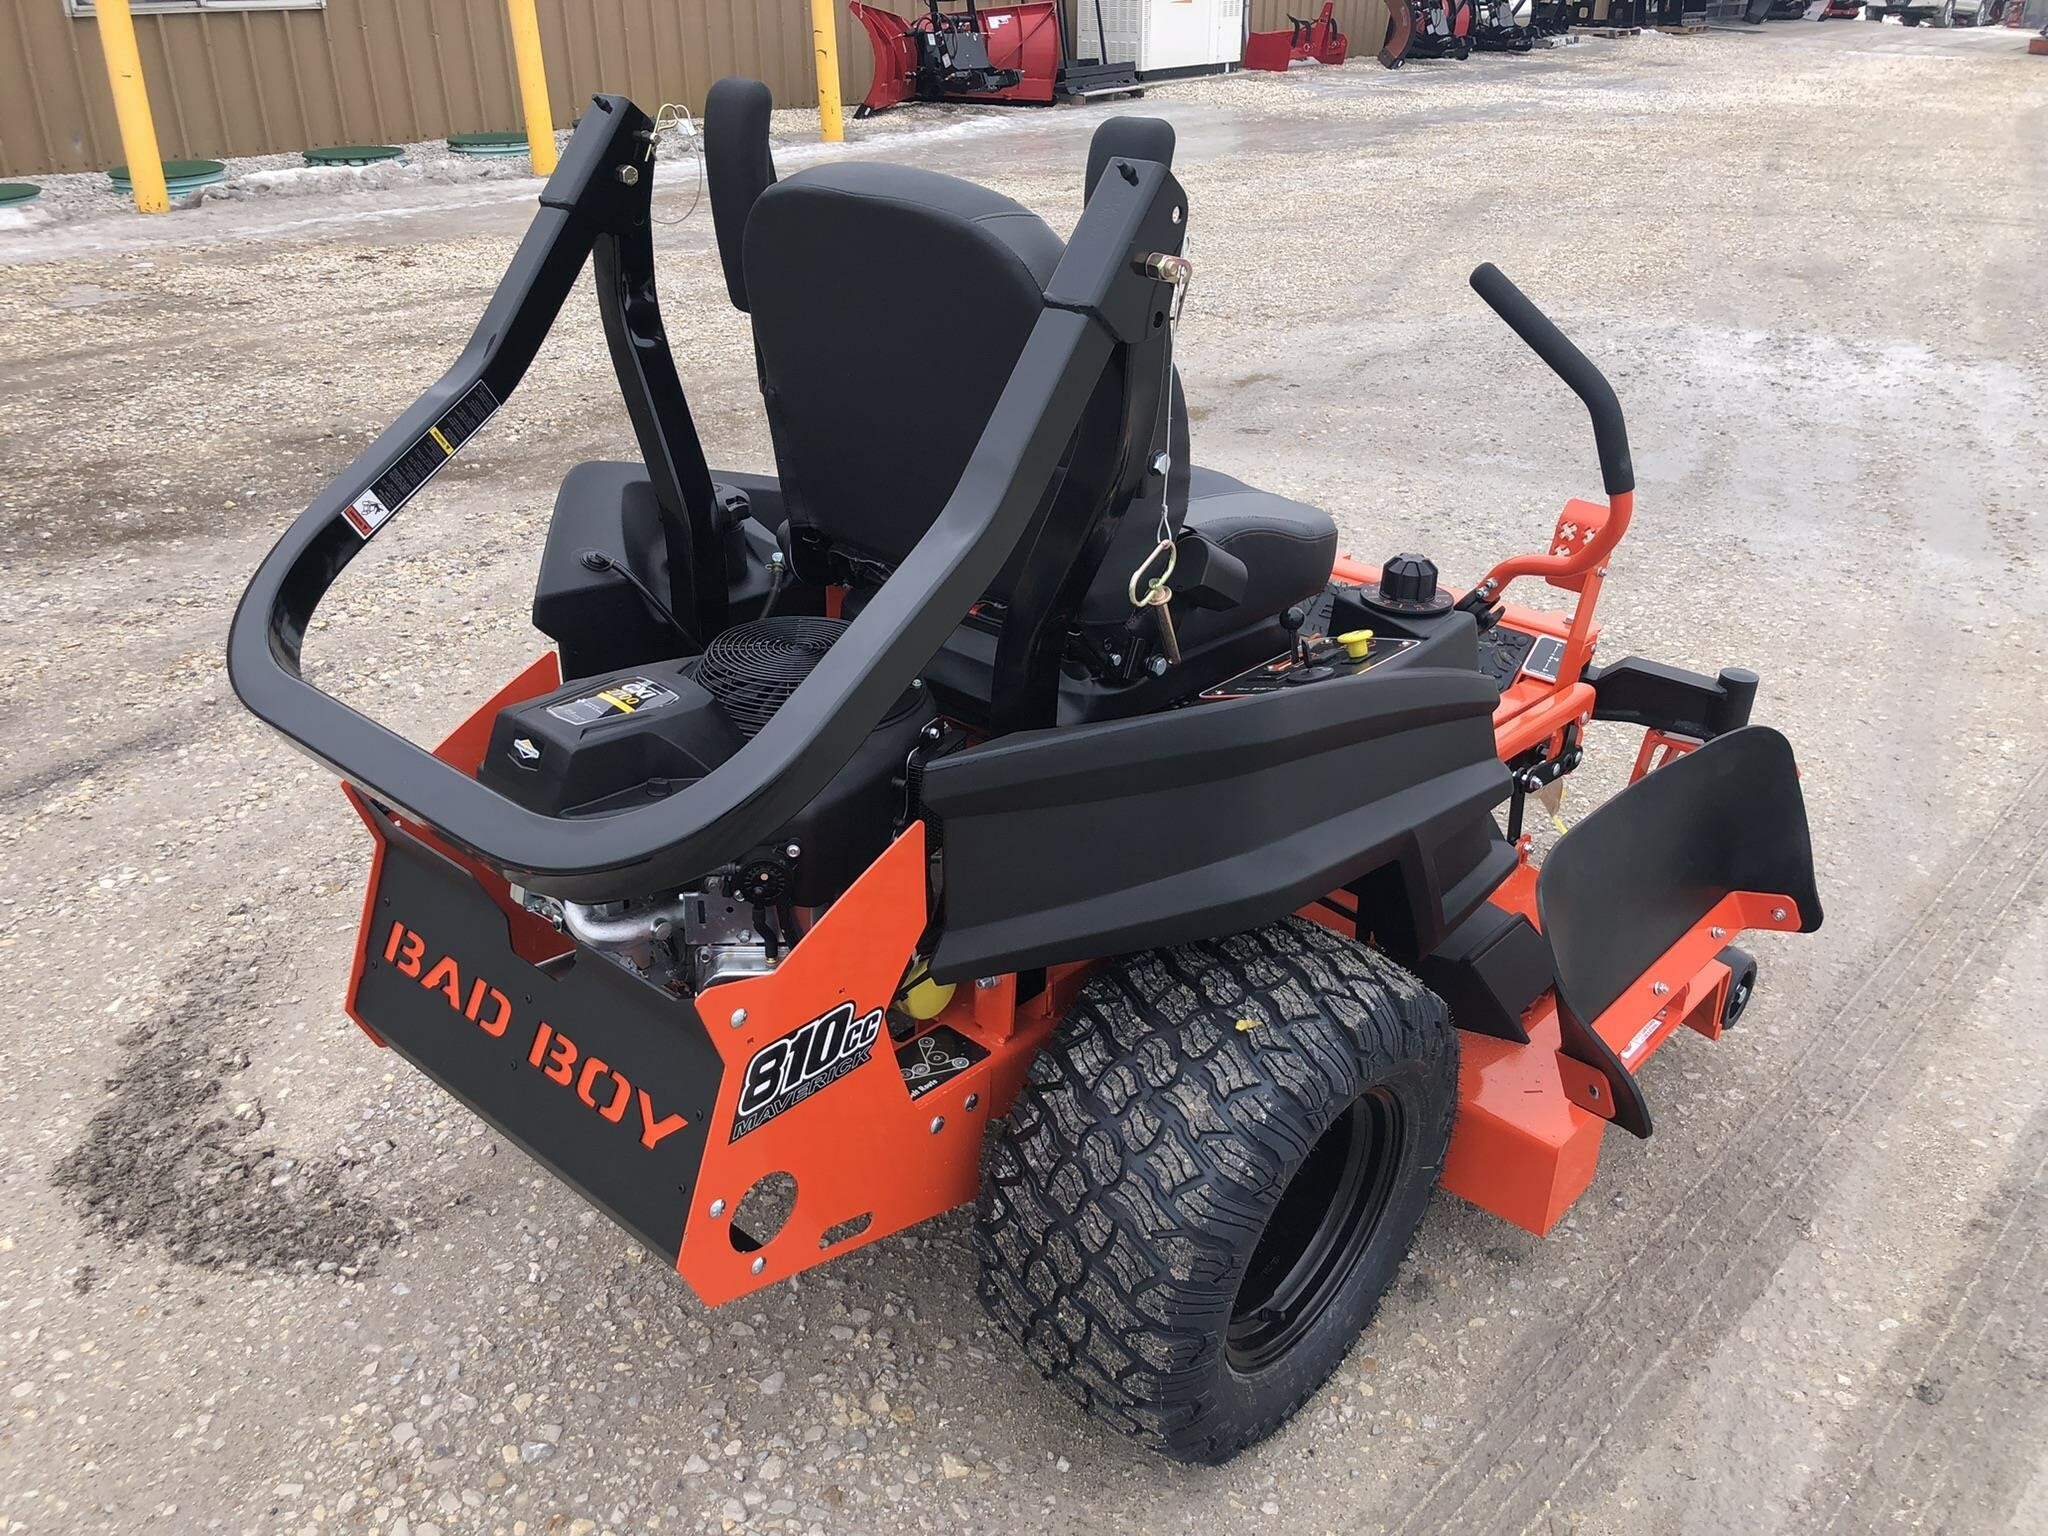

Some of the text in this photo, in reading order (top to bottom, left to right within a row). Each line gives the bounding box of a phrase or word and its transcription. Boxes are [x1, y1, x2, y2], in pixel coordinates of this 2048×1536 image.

[383, 920, 688, 1149] BAD BOY
[732, 1045, 872, 1140] MAVERICK
